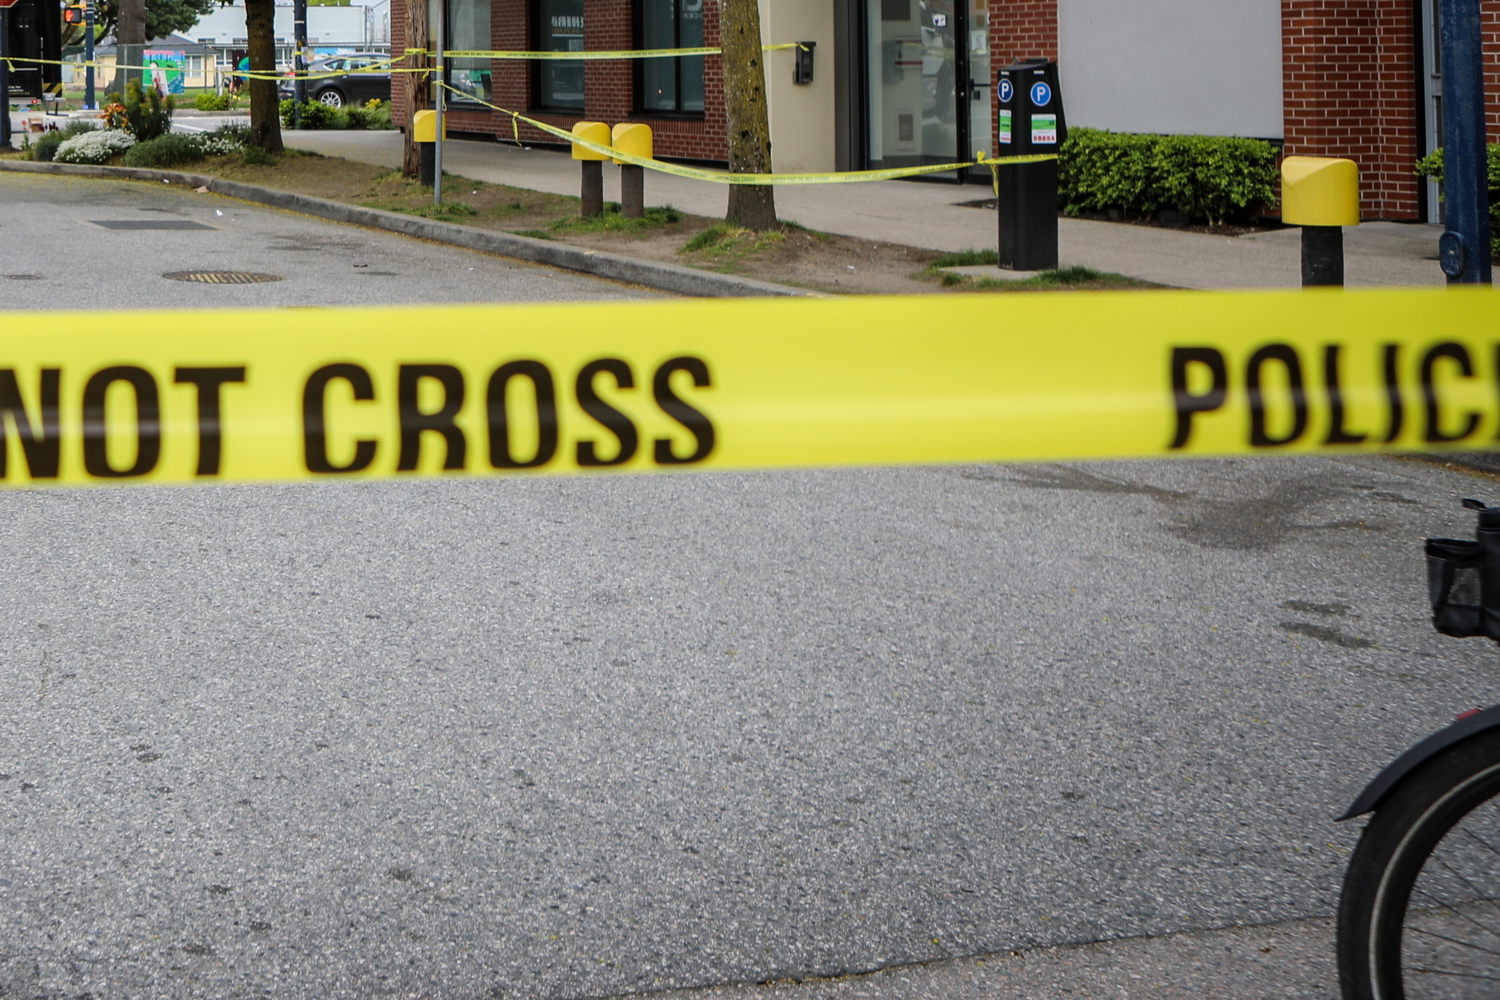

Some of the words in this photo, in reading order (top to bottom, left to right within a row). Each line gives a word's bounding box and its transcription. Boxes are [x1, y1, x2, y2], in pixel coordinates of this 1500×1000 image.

[1001, 82, 1010, 99] P
[1037, 86, 1046, 102] P
[302, 355, 717, 476] CROSS
[1167, 339, 1500, 450] POLIC
